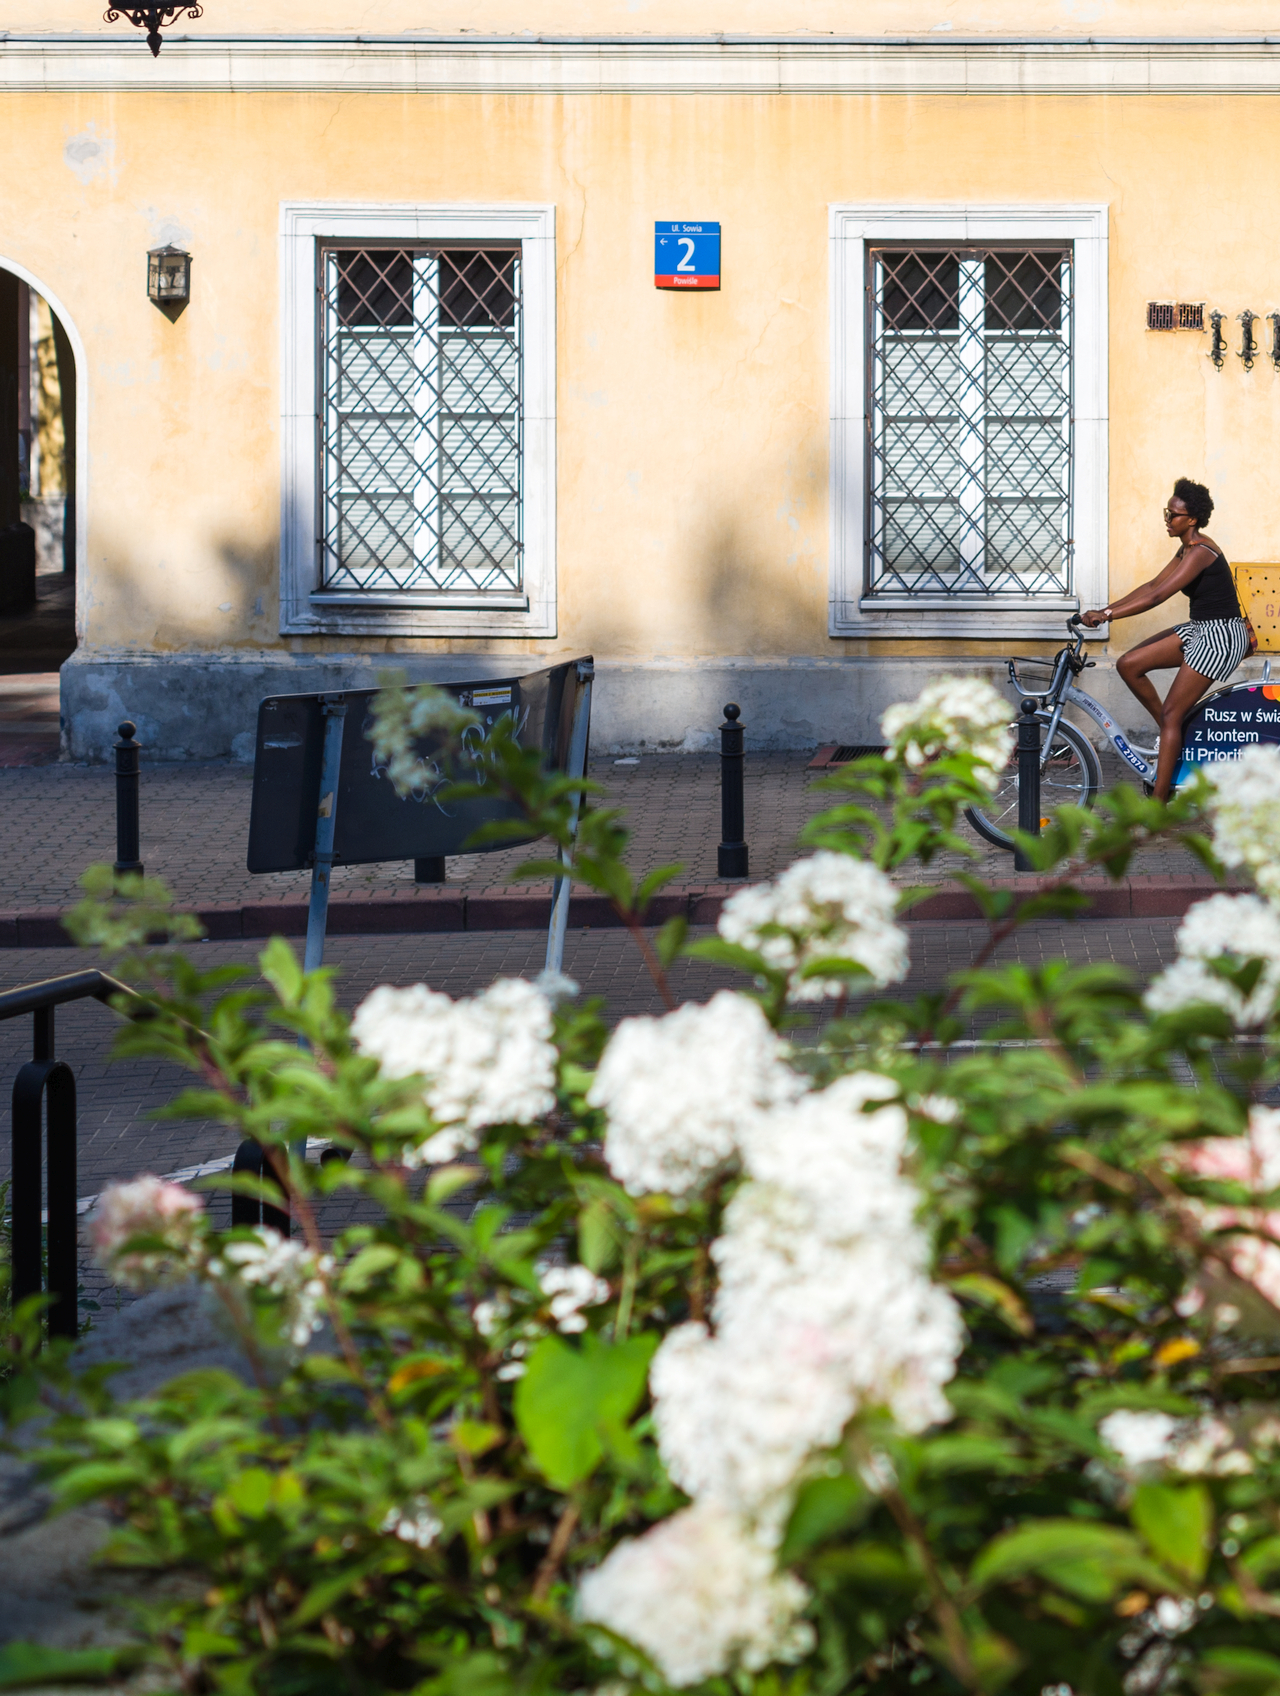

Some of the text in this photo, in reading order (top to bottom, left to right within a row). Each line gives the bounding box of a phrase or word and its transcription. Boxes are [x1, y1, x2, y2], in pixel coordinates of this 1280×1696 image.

[671, 224, 702, 232] Ul. Sowia
[677, 237, 696, 272] 2
[1204, 708, 1237, 722] Rusz
[1240, 711, 1252, 722] w
[1194, 728, 1259, 742] z kontem
[1123, 748, 1146, 771] 27874
